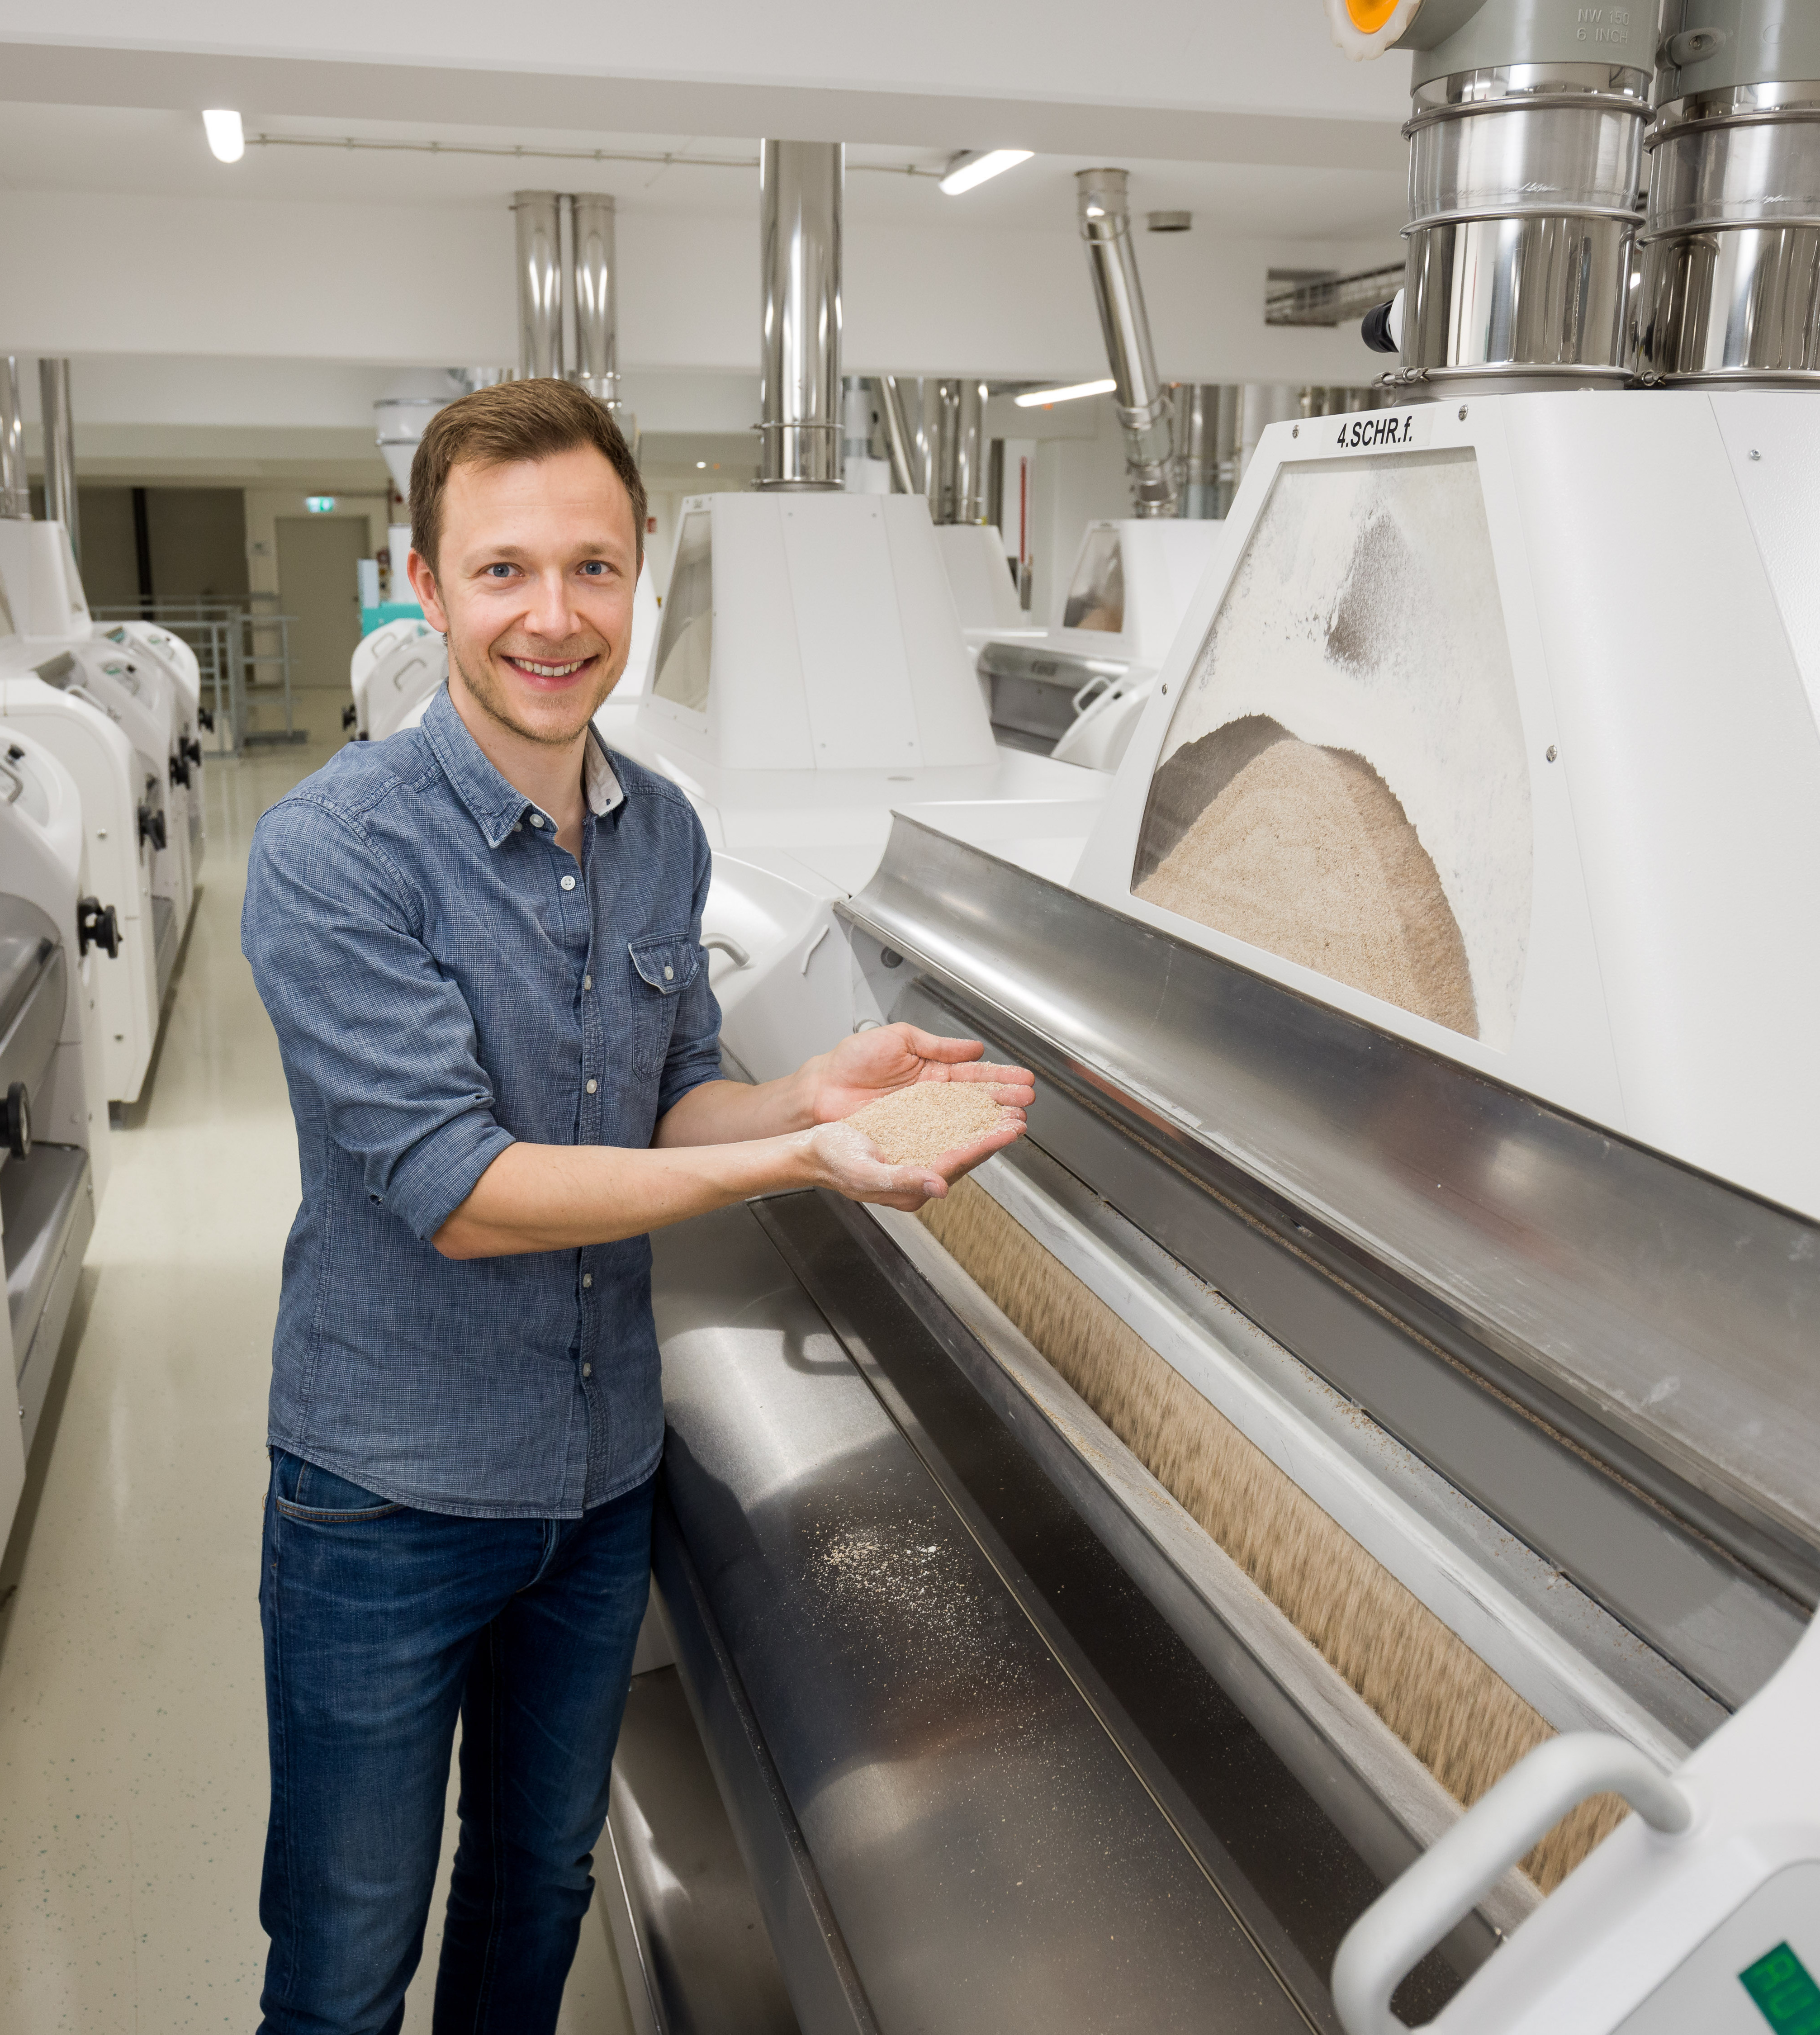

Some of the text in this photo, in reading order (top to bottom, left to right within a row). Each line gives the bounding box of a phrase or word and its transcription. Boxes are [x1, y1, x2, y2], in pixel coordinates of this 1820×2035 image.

[1578, 9, 1629, 25] NW 150
[1577, 28, 1628, 43] 6 INCH
[1337, 416, 1412, 448] 4.SCHR.f.
